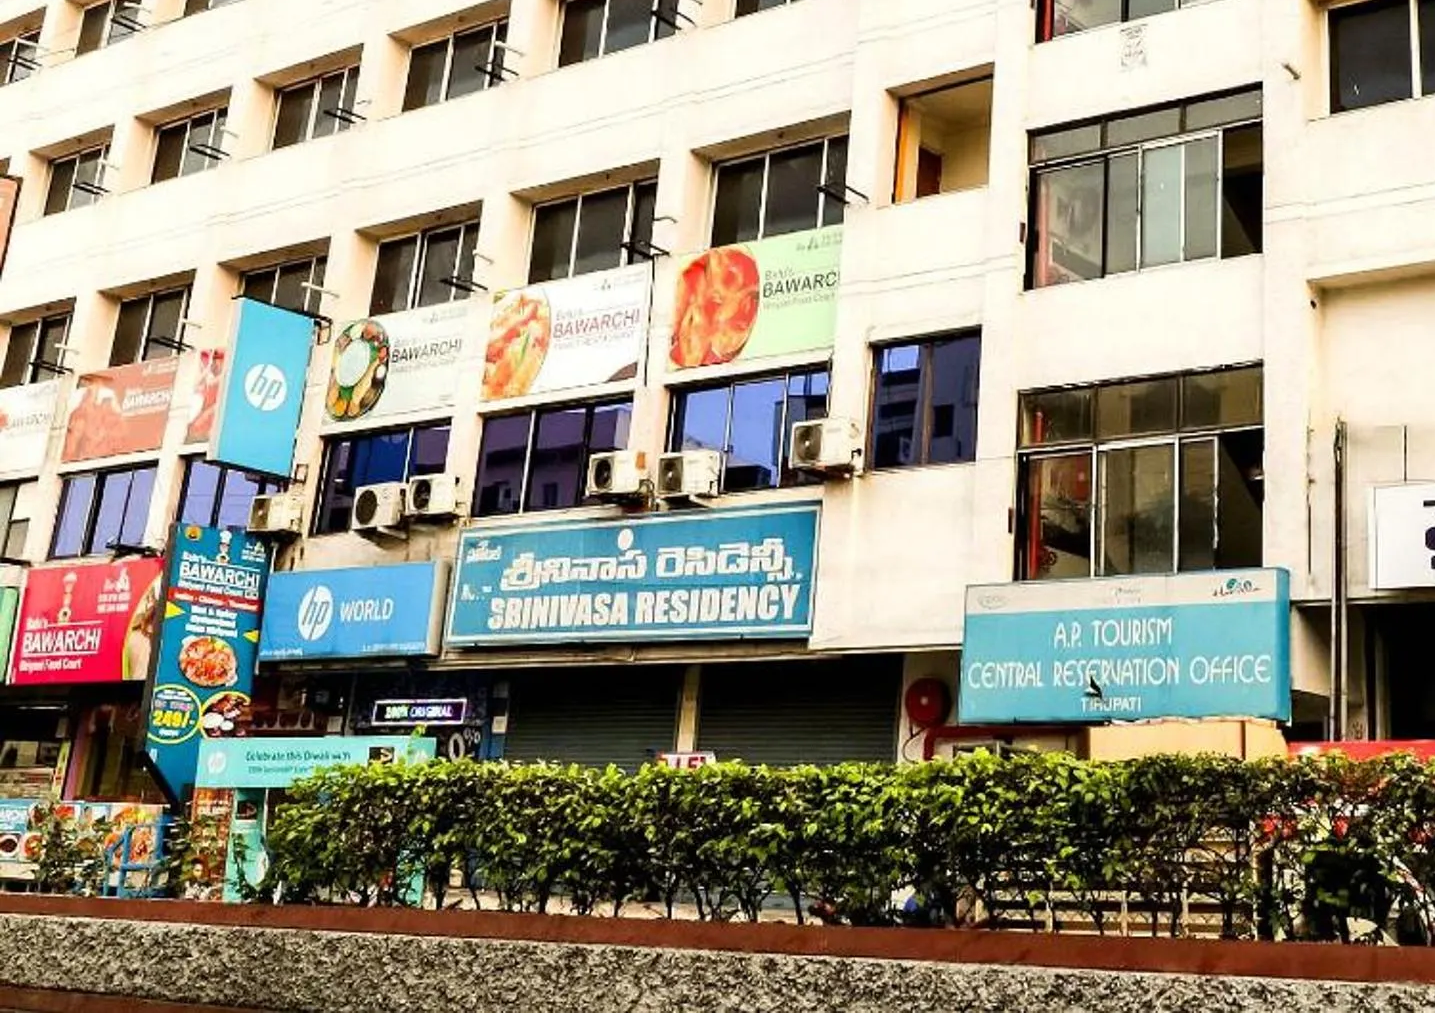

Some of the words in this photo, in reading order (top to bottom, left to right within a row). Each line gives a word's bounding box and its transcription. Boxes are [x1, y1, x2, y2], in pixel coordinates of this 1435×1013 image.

[553, 308, 640, 339] BAWARCHI
[391, 338, 462, 363] BAWARCHI
[247, 364, 285, 411] hp
[179, 561, 260, 589] BAWARCHI
[299, 586, 332, 640] hp
[340, 598, 394, 621] WORLD
[487, 593, 628, 630] SRINIVASA
[635, 584, 801, 624] RESIDENCY
[22, 628, 102, 654] BAWARCHI
[1054, 623, 1082, 649] A.P.
[1091, 617, 1173, 647] TOURISM
[968, 661, 1044, 689] CENTRAL
[1052, 657, 1181, 686] RESERVATION
[1189, 654, 1272, 685] OFFICE
